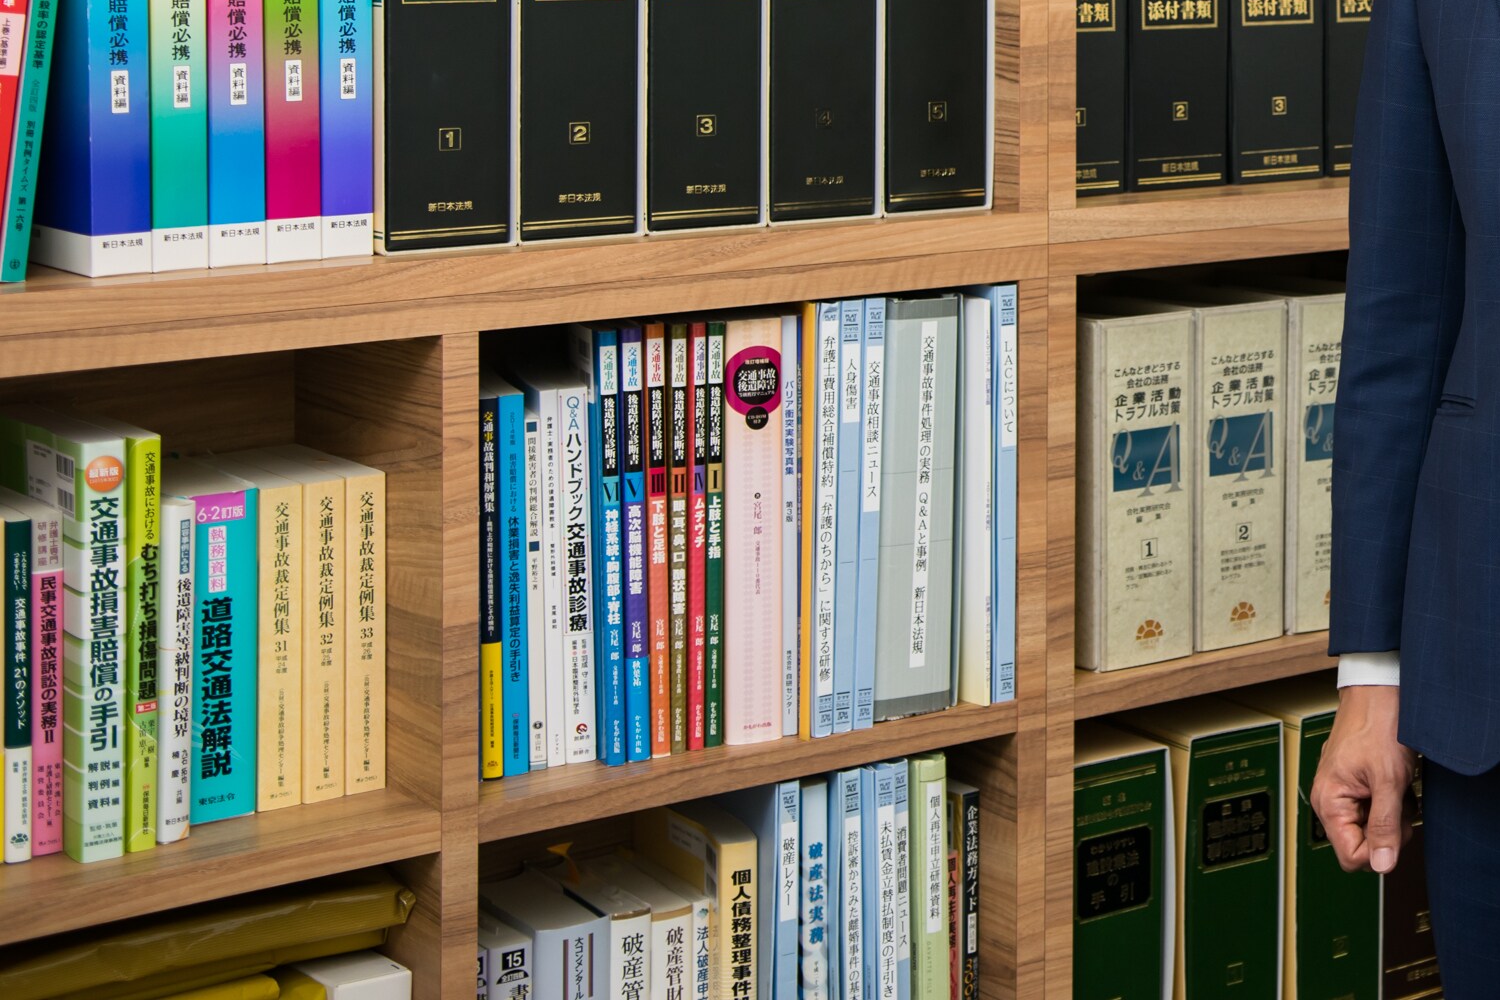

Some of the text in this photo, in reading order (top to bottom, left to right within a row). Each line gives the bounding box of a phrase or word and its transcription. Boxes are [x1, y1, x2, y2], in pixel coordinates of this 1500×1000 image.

[1147, 0, 1212, 21] 添付書類
[113, 74, 127, 110] 資料編
[175, 69, 189, 104] 資料編
[738, 379, 776, 392] 後遺障害
[845, 358, 857, 410] 人身傷害
[1003, 341, 1015, 433] LACについて
[1114, 361, 1181, 379] こんなときどうする
[1126, 375, 1169, 389] 会社の法務
[1211, 350, 1275, 366] こんなときどうする
[1211, 375, 1275, 395] 企業活動
[1223, 363, 1264, 377] 会社の法務
[627, 394, 639, 466] 後遺障害診断書
[785, 380, 794, 476] バリア衝突実験写真集
[866, 361, 881, 498] 交通事故相談ニュース
[1115, 387, 1181, 408] 企業活動
[1115, 402, 1181, 422] トラブル対策
[1211, 389, 1274, 409] トラブル対策
[483, 411, 494, 512] 交通事故裁判和解例集
[604, 398, 616, 470] 後遺障害診断書
[915, 336, 934, 573] 交通事故事件処理の実務 Q&Aと事例
[1110, 421, 1184, 498] Q&A
[89, 467, 119, 478] 最新版
[528, 437, 539, 537] 間接被害者の判例総合解説
[197, 504, 244, 523] 6-2訂版
[652, 500, 666, 564] 下肢と足指
[673, 499, 686, 563] 眼、耳、鼻、口
[695, 498, 705, 548] ムチウチ
[708, 496, 721, 559] 上肢と手指
[819, 335, 836, 682] 弁護士費用総合補償特約 「弁護のちから」に関する研修
[138, 452, 158, 700] 交通事故における むち打ち損傷問題
[210, 528, 226, 590] 執務資料
[273, 502, 290, 652] 交通事故裁定例集 31
[318, 496, 334, 645] 交通事故裁定例集 32
[359, 491, 374, 639] 交通事故裁定例集 33
[605, 509, 621, 625] 神経系統・胸腹部・脊柱
[628, 504, 642, 595] 高次脳機能障害
[90, 497, 119, 751] 交通事故損害賠償の手引
[508, 517, 521, 682] 休業損害と逸失利益算定の手引き
[174, 578, 190, 737] 後遺障害等級判断の境界
[201, 597, 233, 779] 道路交通法解説
[88, 761, 120, 773] 解説編
[88, 779, 120, 791] 判例編
[199, 793, 236, 806] 東京法令
[782, 838, 795, 906] 破産レター
[897, 827, 908, 948] 消費者問題ニュース
[930, 796, 941, 918] 個人再生申立研修資料
[966, 805, 978, 912] 企業法務ガイド
[808, 842, 824, 944] 破産法実務
[881, 821, 894, 998] 未払賃金立替払制度の手引き
[506, 953, 521, 967] 15
[575, 937, 583, 1000] 大コンメンタール
